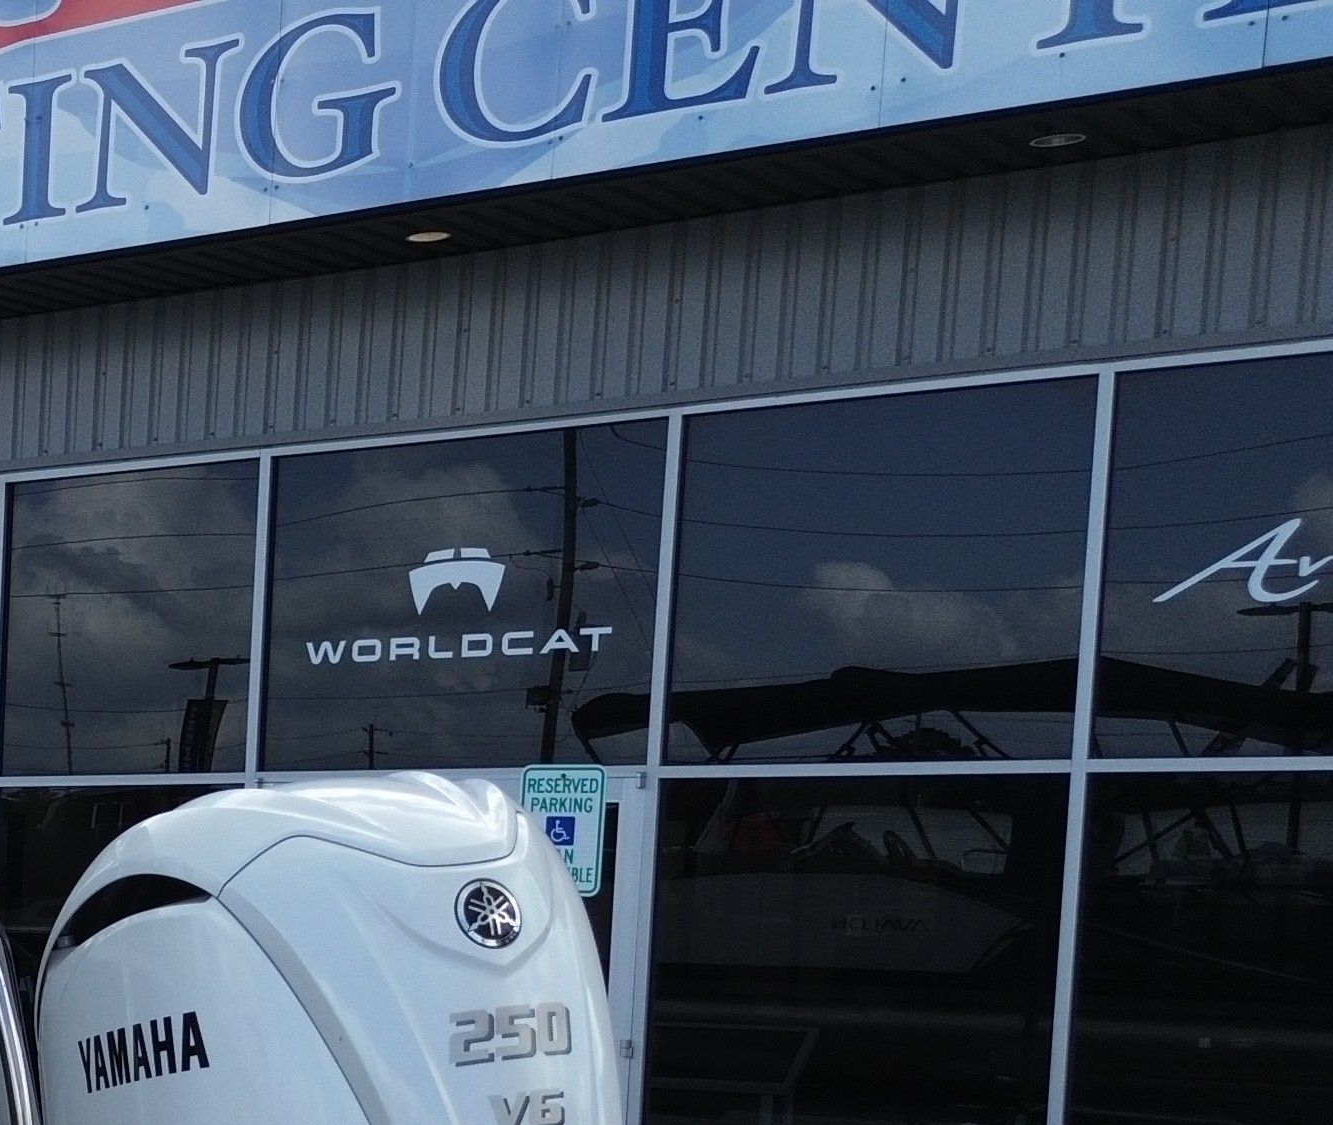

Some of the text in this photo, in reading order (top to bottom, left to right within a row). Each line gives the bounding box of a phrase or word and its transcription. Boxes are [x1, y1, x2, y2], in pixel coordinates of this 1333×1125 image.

[305, 626, 613, 665] WORLDCAT
[527, 777, 599, 794] RESERVED
[530, 797, 593, 813] PARKING
[77, 1011, 209, 1094] YAMAHA
[447, 1002, 572, 1067] 250
